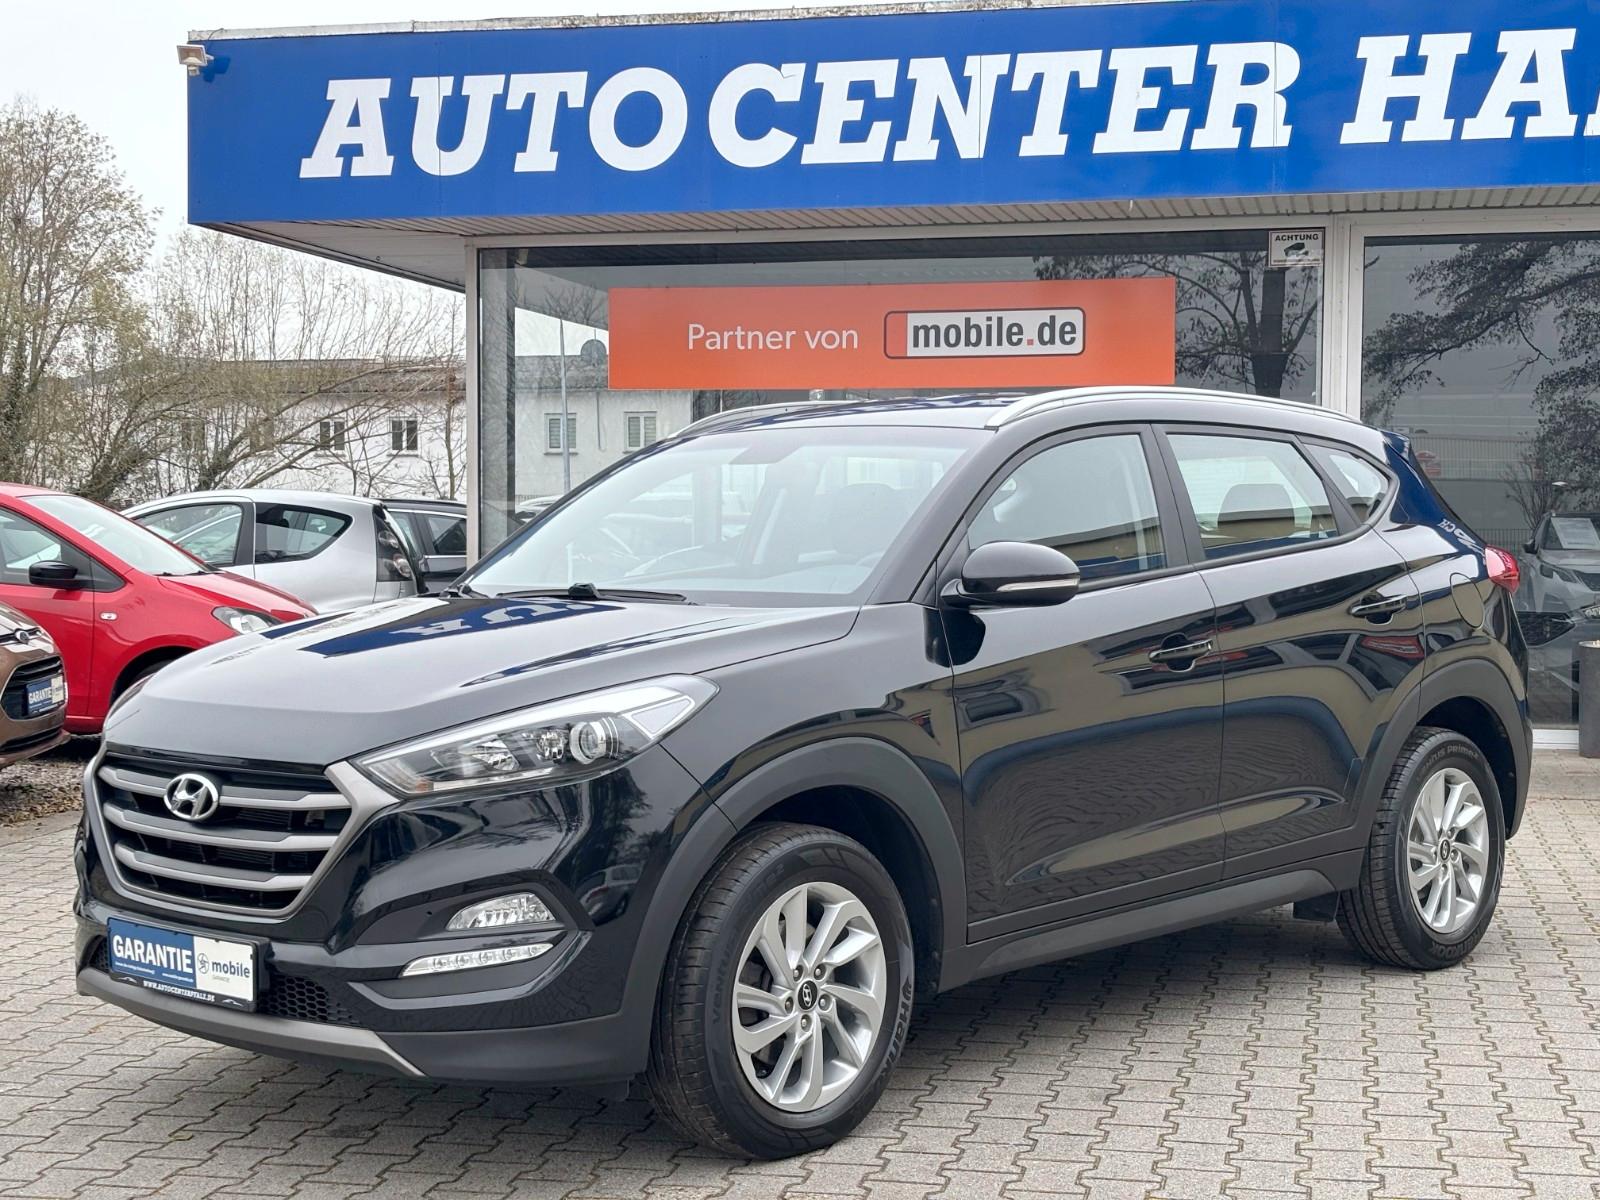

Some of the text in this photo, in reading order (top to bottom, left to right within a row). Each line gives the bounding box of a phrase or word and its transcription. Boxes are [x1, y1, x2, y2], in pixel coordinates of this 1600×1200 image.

[1340, 28, 1600, 145] HA
[1275, 233, 1319, 242] ACHTUNG
[688, 315, 1077, 351] Partner von mobile.de
[29, 687, 52, 704] GARANTIE
[112, 935, 194, 974] GARANTIE
[211, 960, 251, 978] mobile
